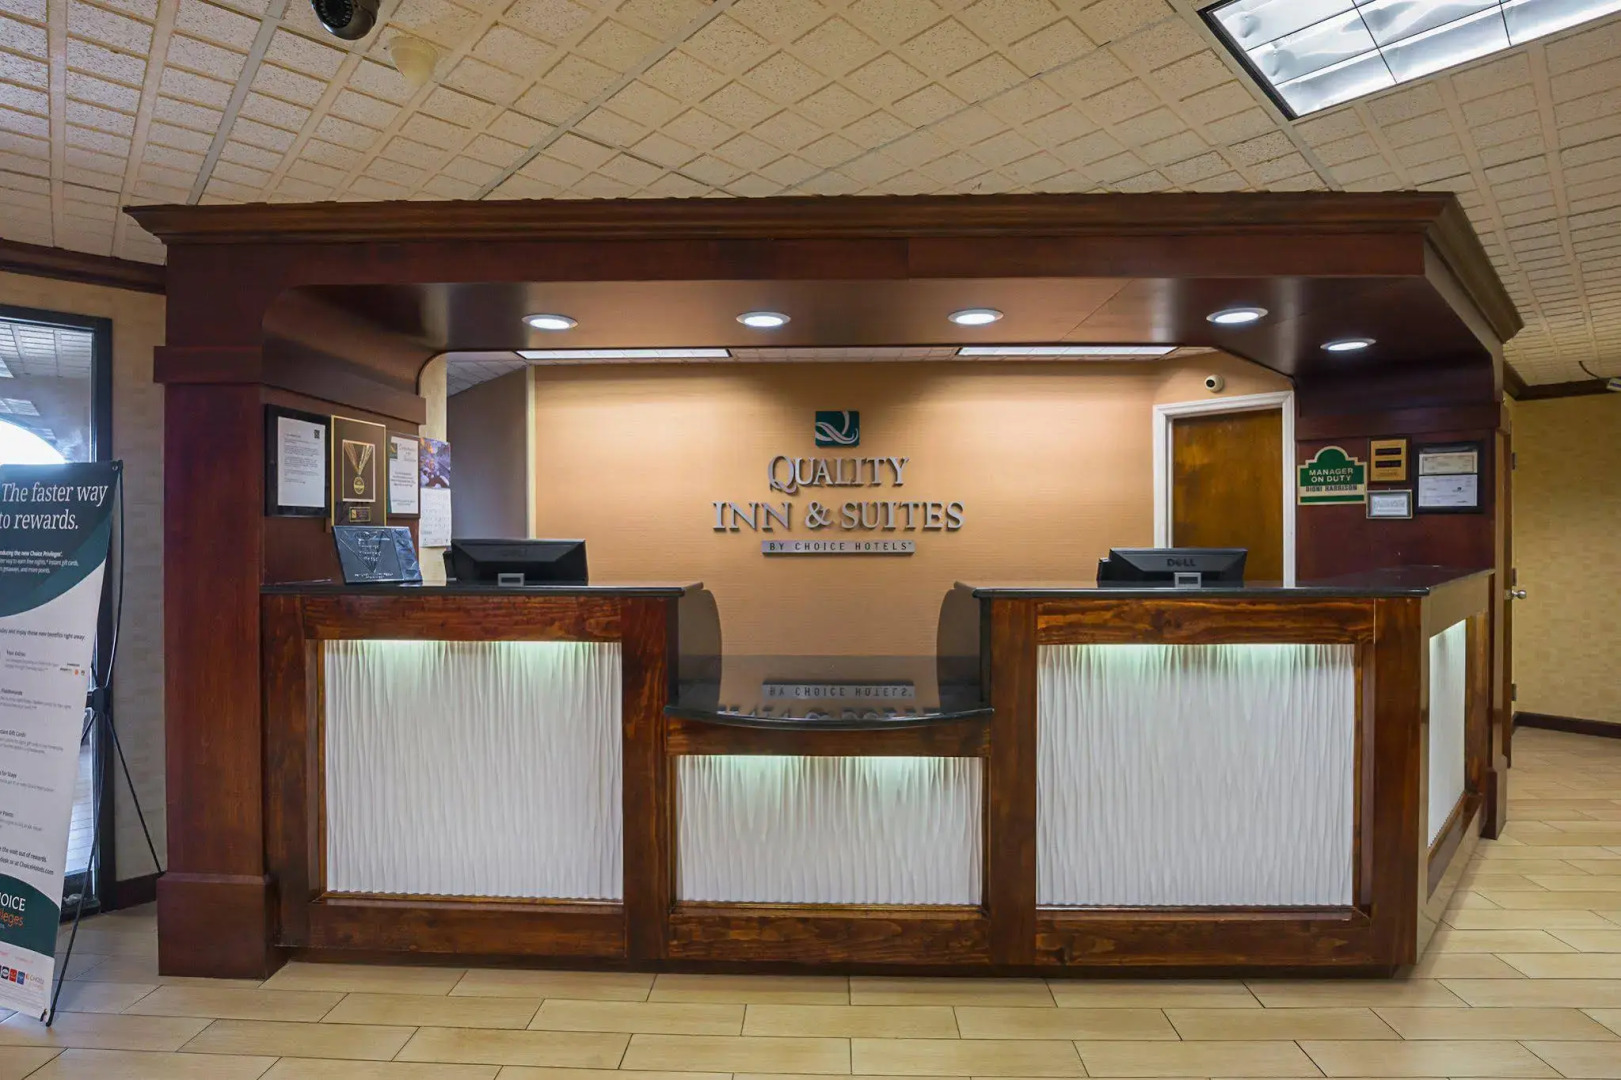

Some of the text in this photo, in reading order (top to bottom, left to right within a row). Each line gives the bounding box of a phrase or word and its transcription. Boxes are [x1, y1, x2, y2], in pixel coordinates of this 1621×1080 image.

[767, 455, 909, 495] QUALITY
[1308, 467, 1354, 476] MANAGER
[1326, 474, 1352, 482] DUTY
[2, 482, 109, 507] The faster way
[14, 508, 79, 530] rewards.
[713, 501, 966, 534] INN & SUITES
[769, 542, 785, 551] BY
[794, 542, 846, 551] CHOICE
[1166, 558, 1197, 567] DELL
[0, 892, 26, 912] OICE
